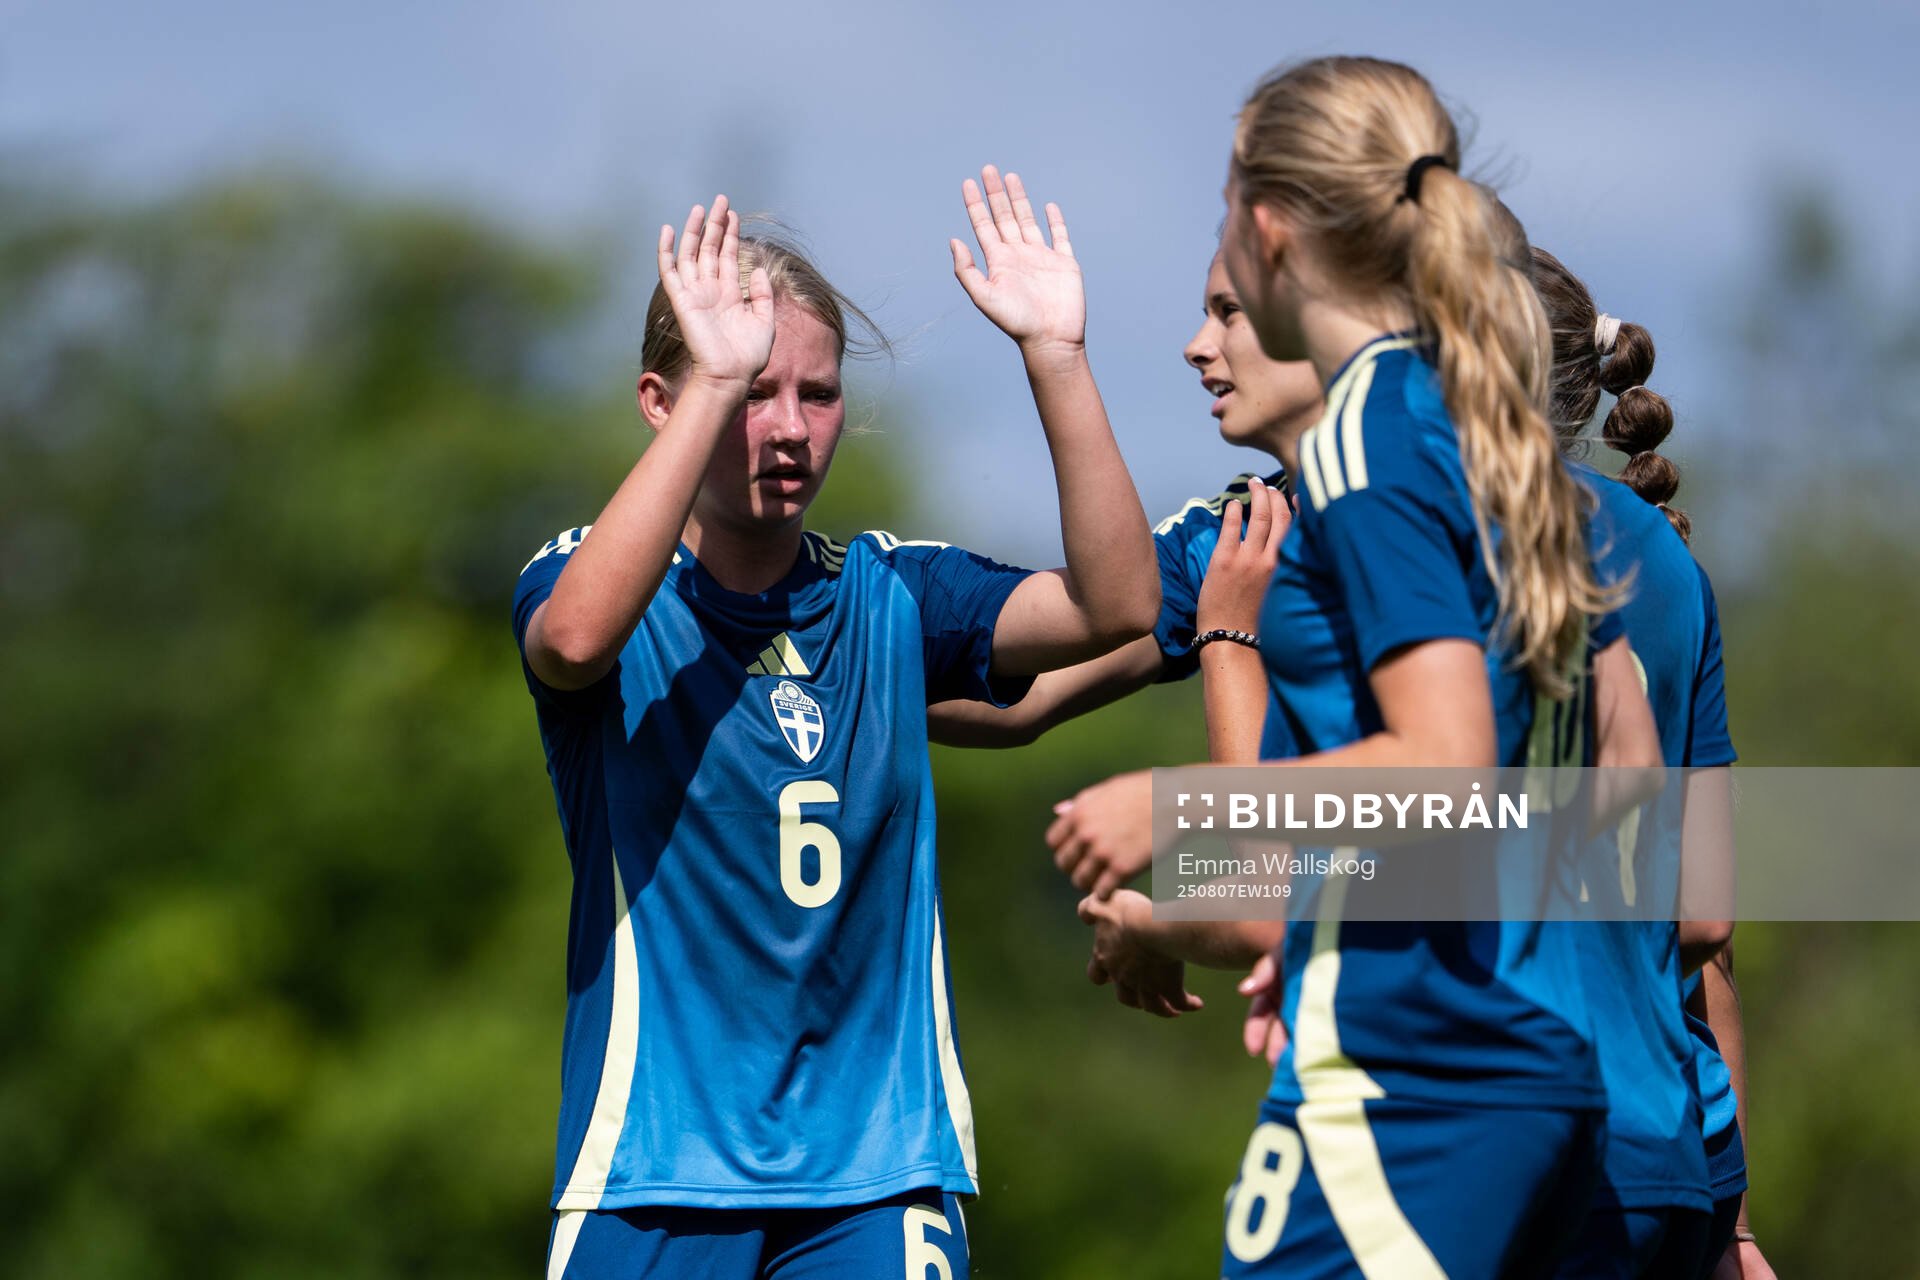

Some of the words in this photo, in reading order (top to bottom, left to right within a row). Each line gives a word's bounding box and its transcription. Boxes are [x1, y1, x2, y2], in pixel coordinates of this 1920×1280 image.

[778, 700, 813, 712] SVERIGE
[779, 780, 841, 908] 6
[903, 1203, 952, 1280] 6
